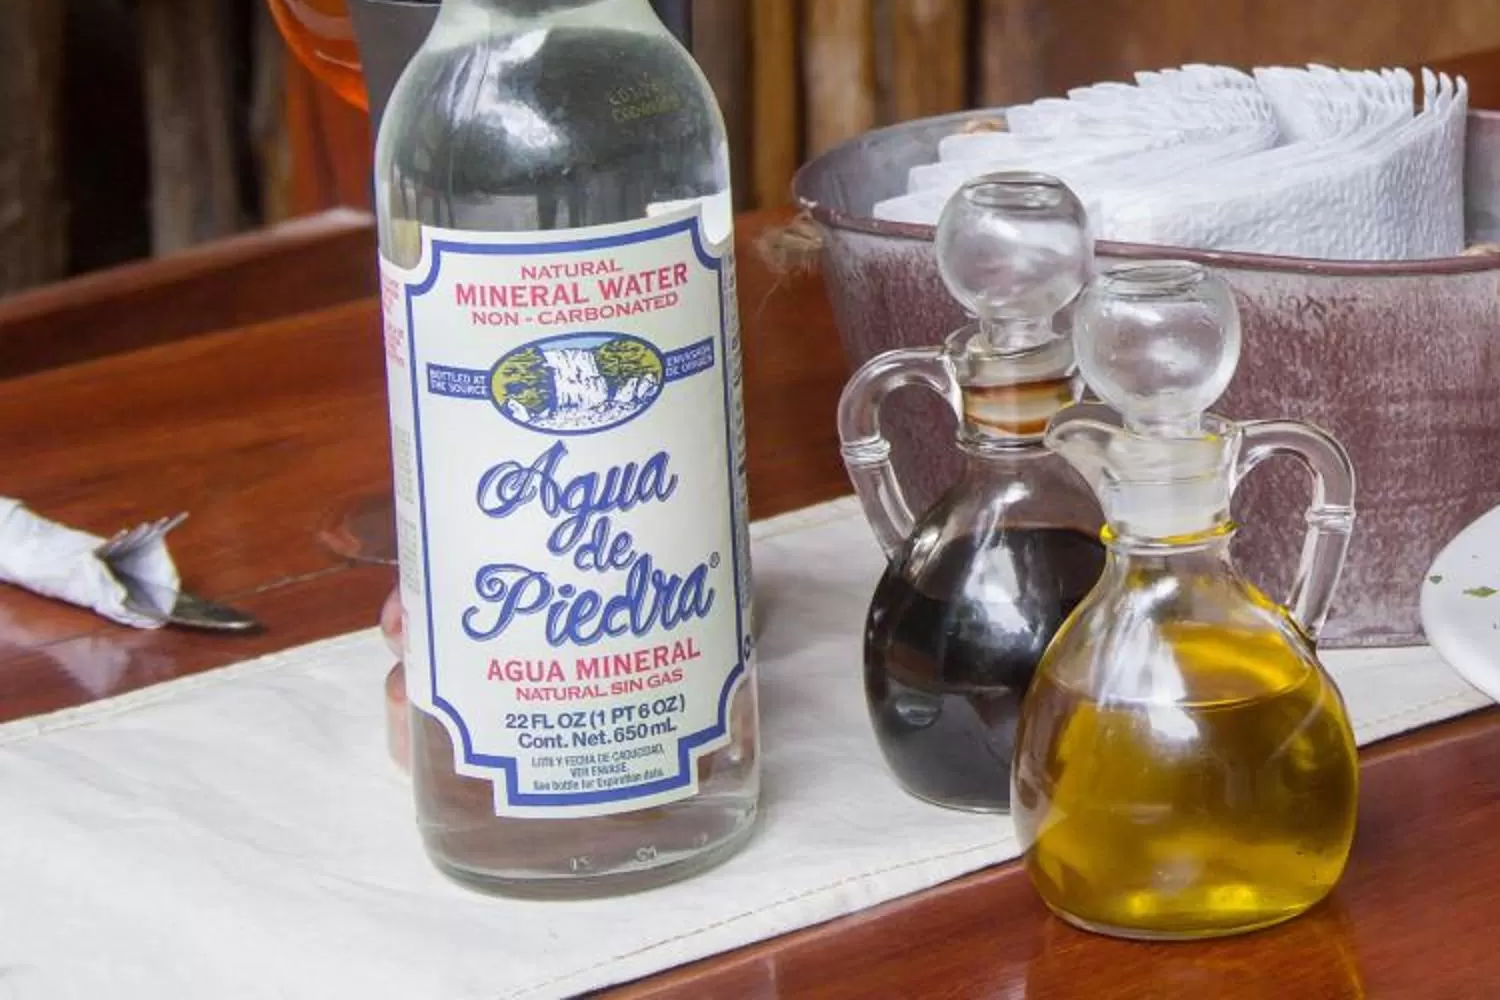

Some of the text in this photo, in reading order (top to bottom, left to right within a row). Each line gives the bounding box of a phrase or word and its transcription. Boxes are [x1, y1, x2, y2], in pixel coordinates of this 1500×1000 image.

[456, 263, 688, 307] MINERAL WATER
[521, 259, 624, 280] NATURAL
[476, 440, 678, 556] Agua
[574, 515, 637, 572] de
[487, 637, 701, 683] AGUA MINERAL
[516, 668, 684, 701] NATURAL SIN GAS
[505, 693, 686, 730] 22 FL OZ (1 PT 6 OZ)
[518, 732, 568, 749] Cont.
[614, 723, 649, 743] 650
[650, 717, 678, 736] mL
